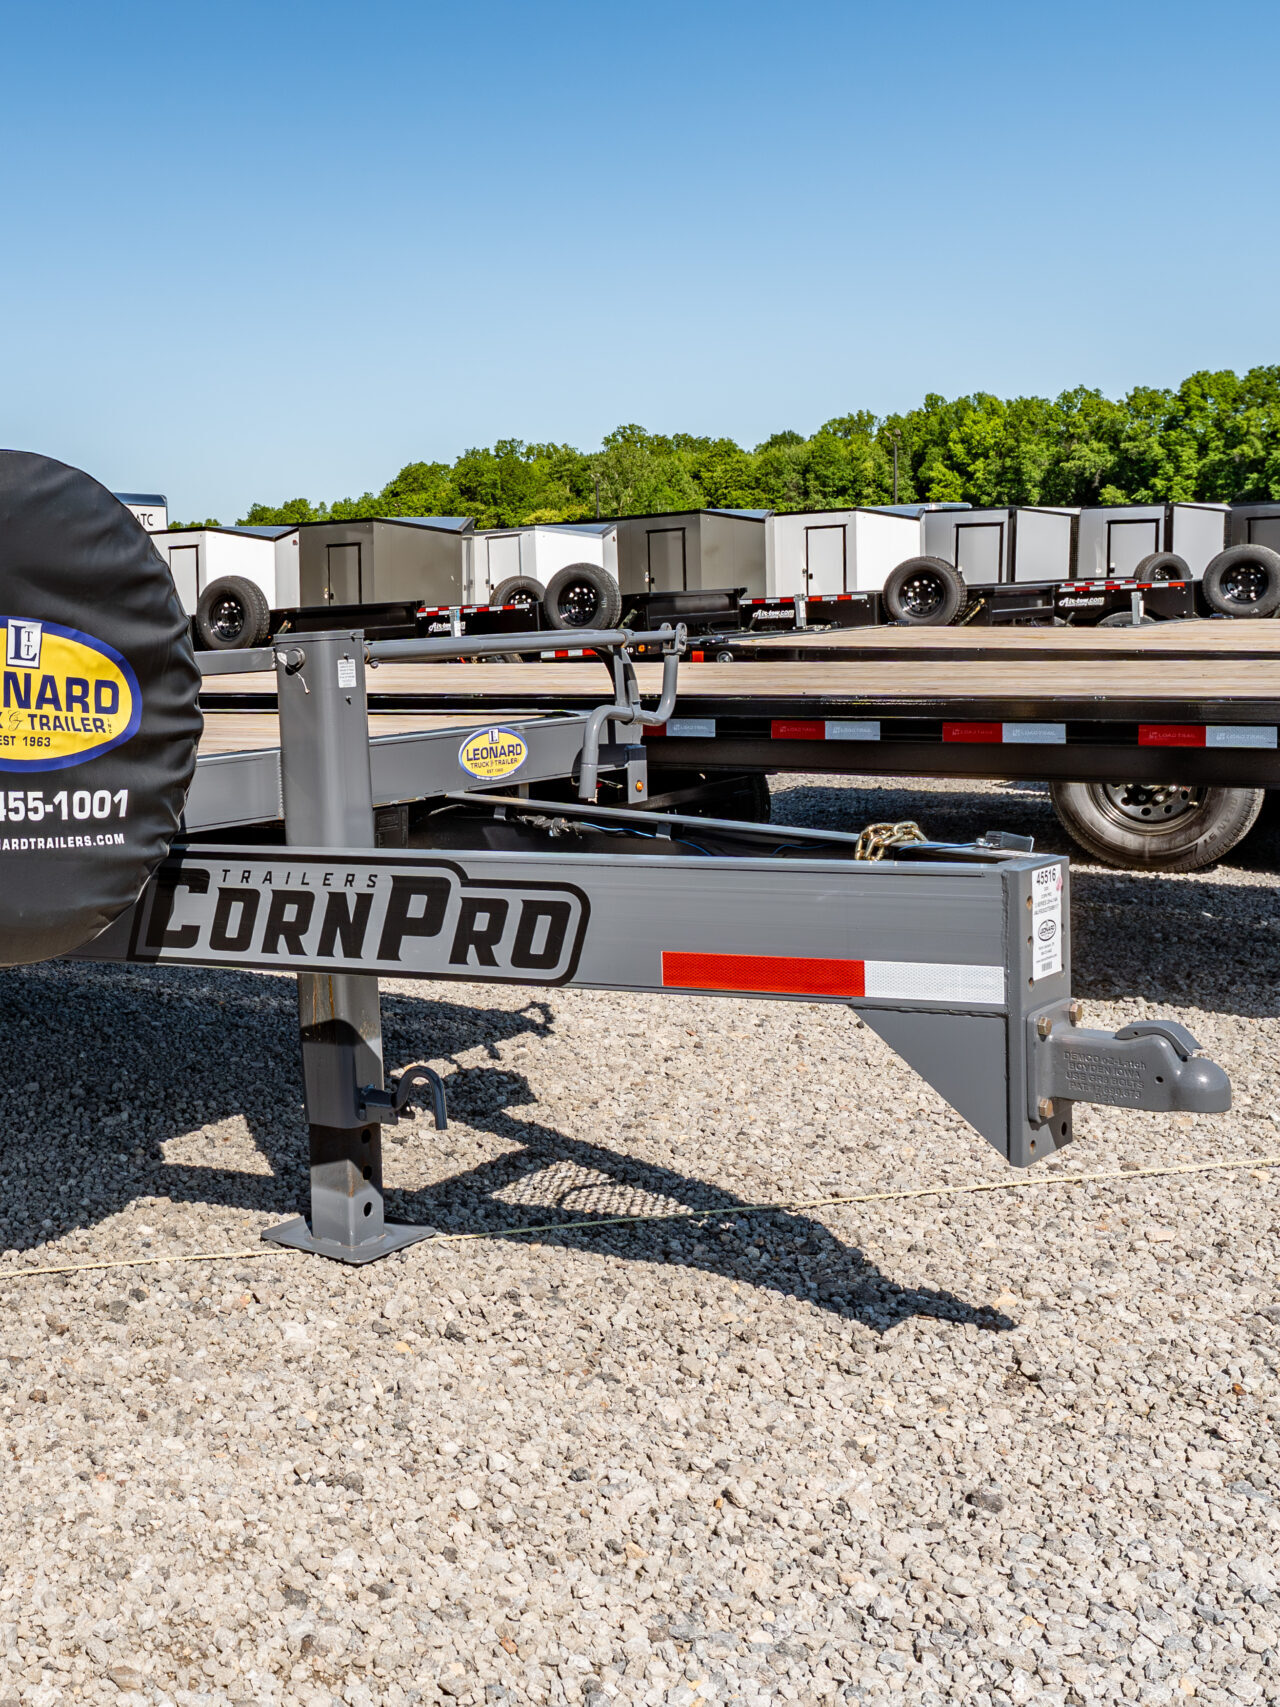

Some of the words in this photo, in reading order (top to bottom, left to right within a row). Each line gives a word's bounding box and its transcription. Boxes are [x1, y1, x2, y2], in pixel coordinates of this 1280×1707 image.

[27, 713, 106, 734] TRAILER
[22, 736, 51, 747] 1963
[466, 743, 522, 761] LEONARD
[471, 761, 489, 769] TRUCK
[494, 757, 518, 766] TRAILER
[221, 868, 379, 889] TRAILERS
[1036, 867, 1056, 886] 45516
[1063, 1051, 1100, 1063] DEMCO
[1067, 1062, 1111, 1075] BOYDEN
[1112, 1068, 1141, 1080] IOWA
[1065, 1071, 1087, 1081] USE
[1111, 1077, 1145, 1090] BOLTS
